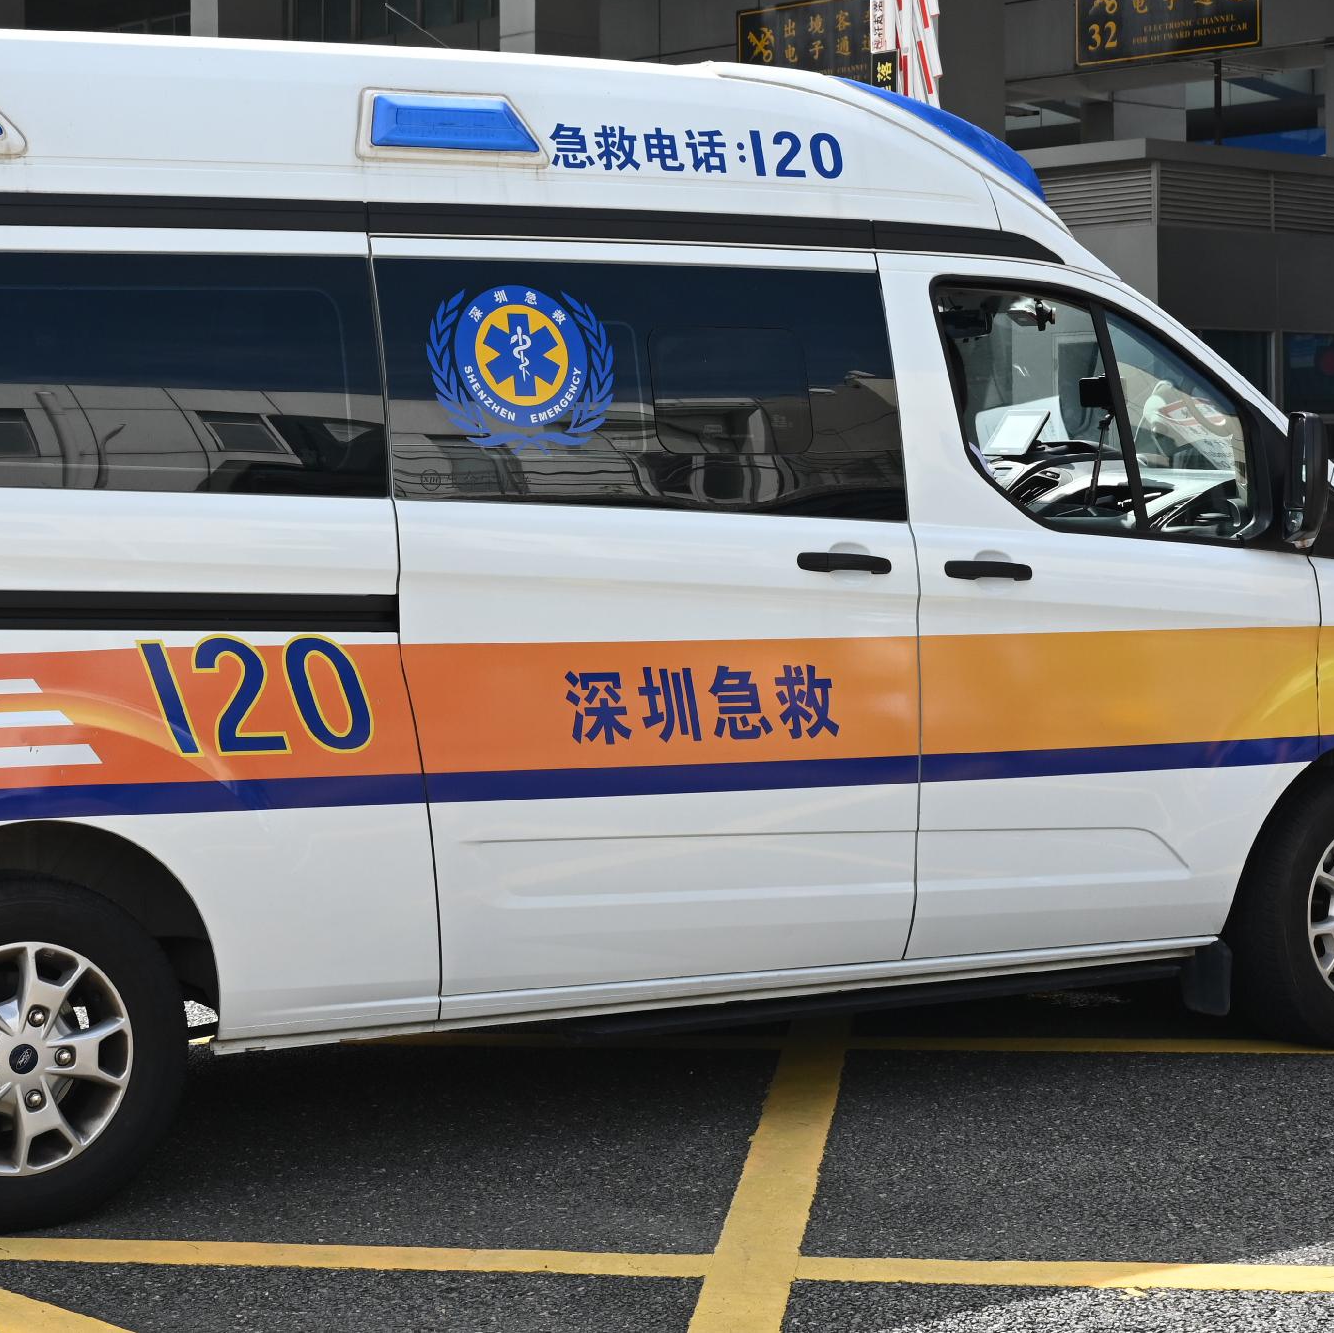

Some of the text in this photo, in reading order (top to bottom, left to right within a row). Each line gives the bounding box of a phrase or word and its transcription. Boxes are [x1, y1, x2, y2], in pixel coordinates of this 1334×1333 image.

[1087, 21, 1118, 51] 32
[1196, 13, 1237, 26] CHANNEL
[1230, 23, 1249, 32] CAR
[468, 290, 566, 326] 深圳急救
[464, 365, 582, 424] SHENZHEN EMERGENCY
[135, 633, 375, 758] 120
[565, 664, 841, 747] 深圳急救
